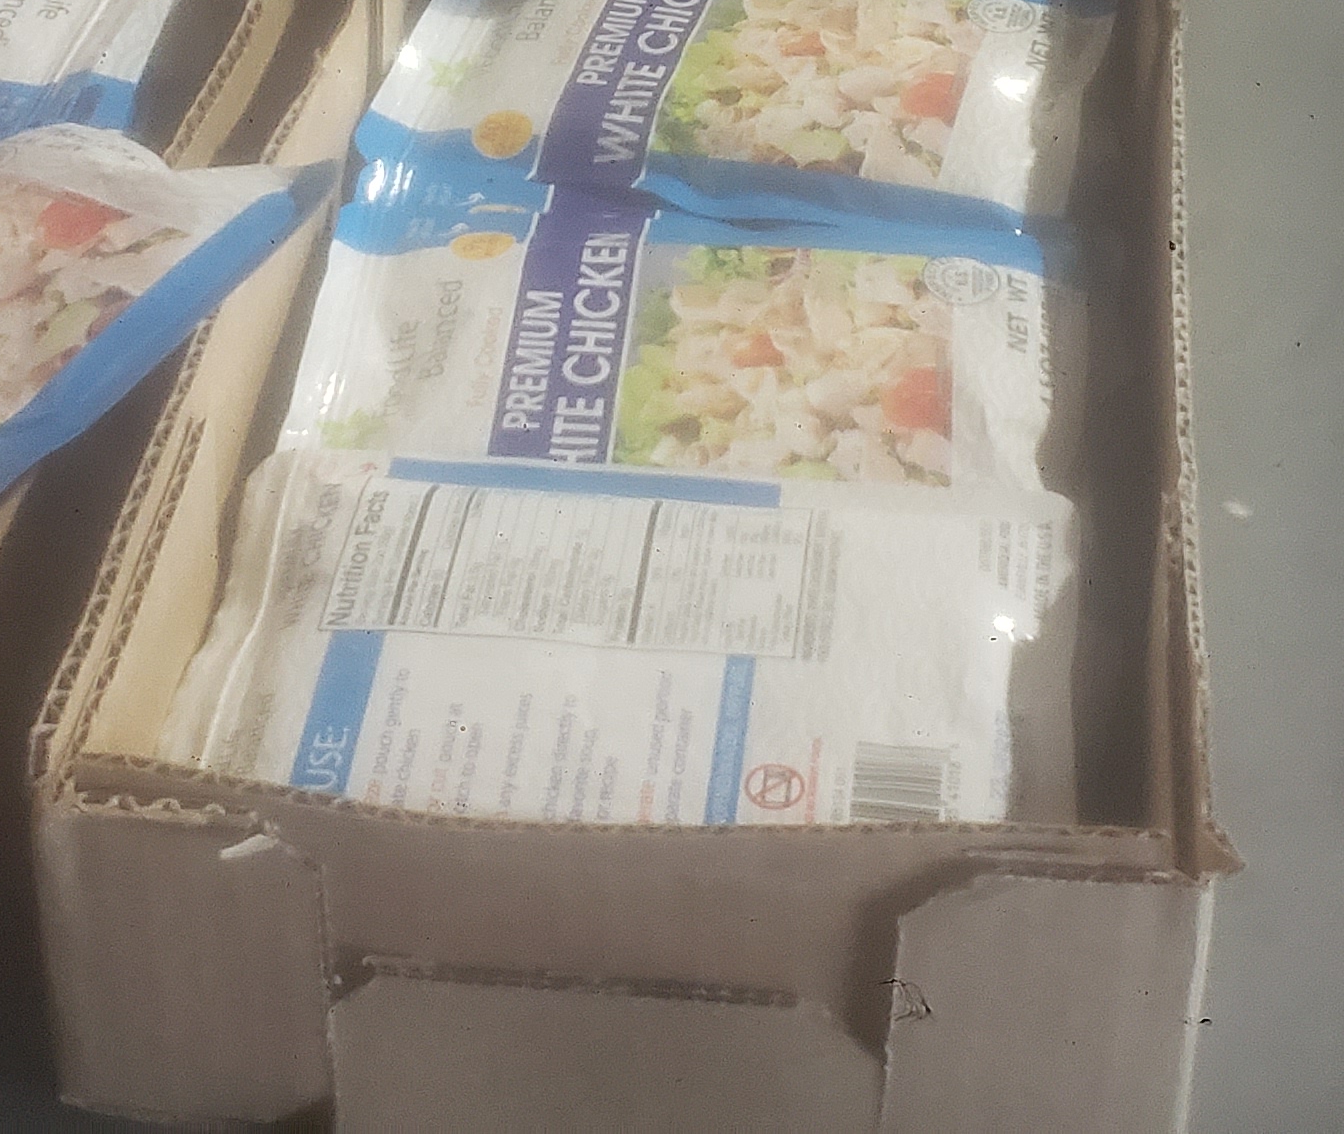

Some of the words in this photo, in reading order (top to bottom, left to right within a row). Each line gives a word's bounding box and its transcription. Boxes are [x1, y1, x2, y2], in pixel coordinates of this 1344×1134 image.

[594, 61, 662, 164] WHITE
[562, 230, 631, 390] CHICKEN
[1006, 274, 1026, 302] WT
[1006, 310, 1032, 354] NET
[502, 289, 564, 433] PREMIUM
[326, 541, 372, 626] Nutrition
[354, 491, 389, 535] Facts
[396, 668, 409, 680] to
[385, 685, 408, 726] gently
[305, 725, 349, 790] USE:
[372, 730, 394, 778] pouch
[397, 729, 420, 781] chicken
[504, 733, 524, 777] excess
[554, 712, 578, 761] directly
[673, 709, 694, 774] container
[499, 782, 516, 807] any
